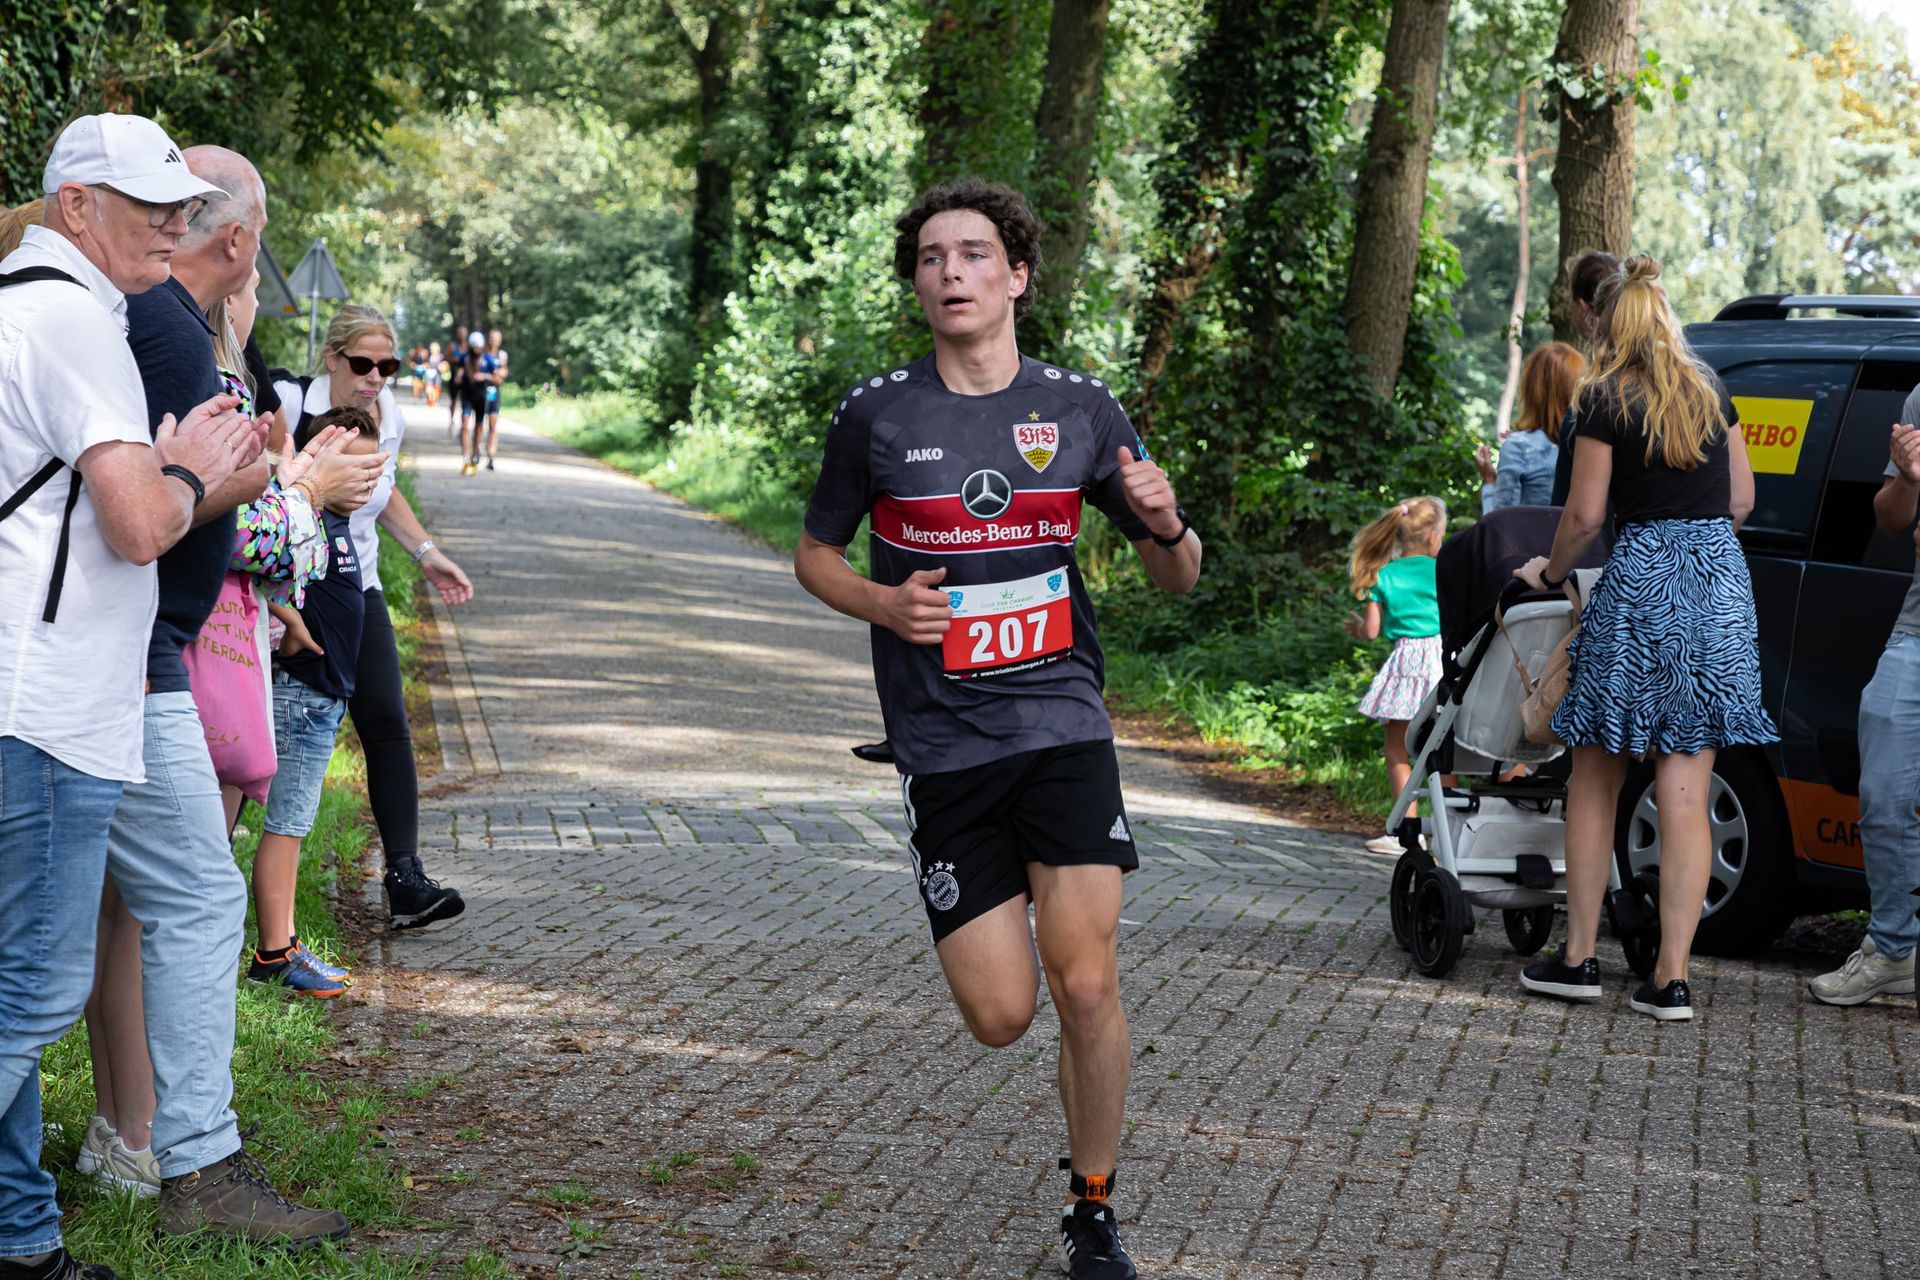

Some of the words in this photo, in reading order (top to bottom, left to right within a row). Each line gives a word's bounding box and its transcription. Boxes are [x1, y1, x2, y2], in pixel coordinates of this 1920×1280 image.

[1740, 423, 1797, 448] HBO
[905, 447, 944, 463] JAKO
[902, 523, 1032, 545] Mercedes-Benz
[968, 609, 1048, 664] 207
